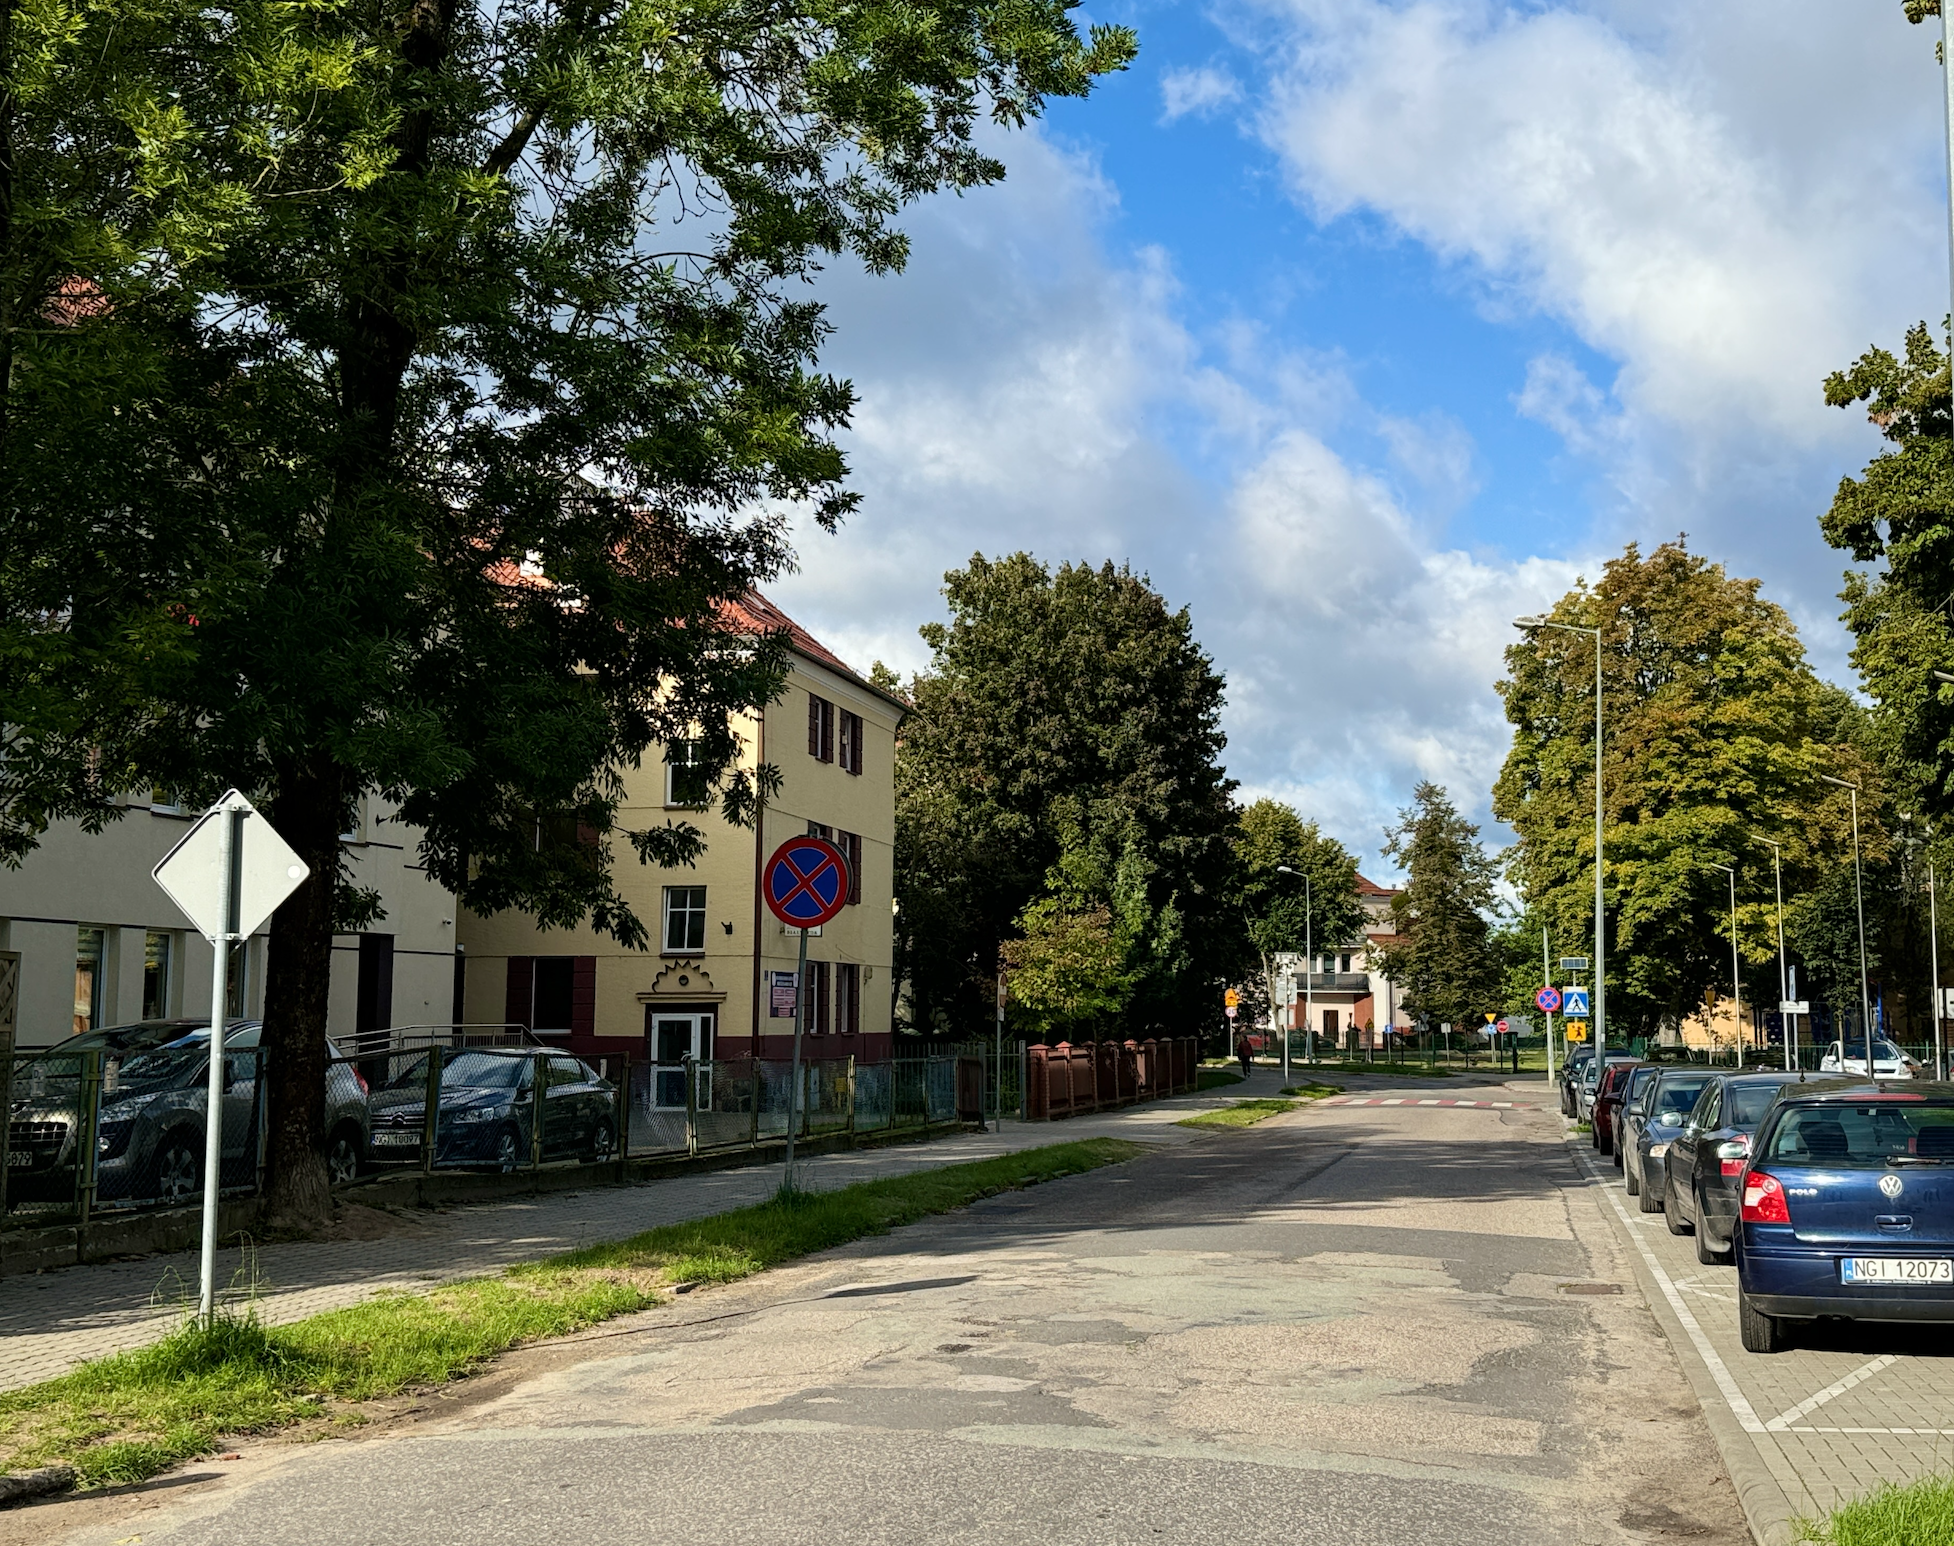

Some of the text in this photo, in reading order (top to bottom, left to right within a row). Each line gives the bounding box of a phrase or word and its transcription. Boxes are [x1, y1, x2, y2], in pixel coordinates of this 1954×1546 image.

[1788, 1188, 1818, 1196] POLO
[1854, 1260, 1950, 1278] NGI 12073
